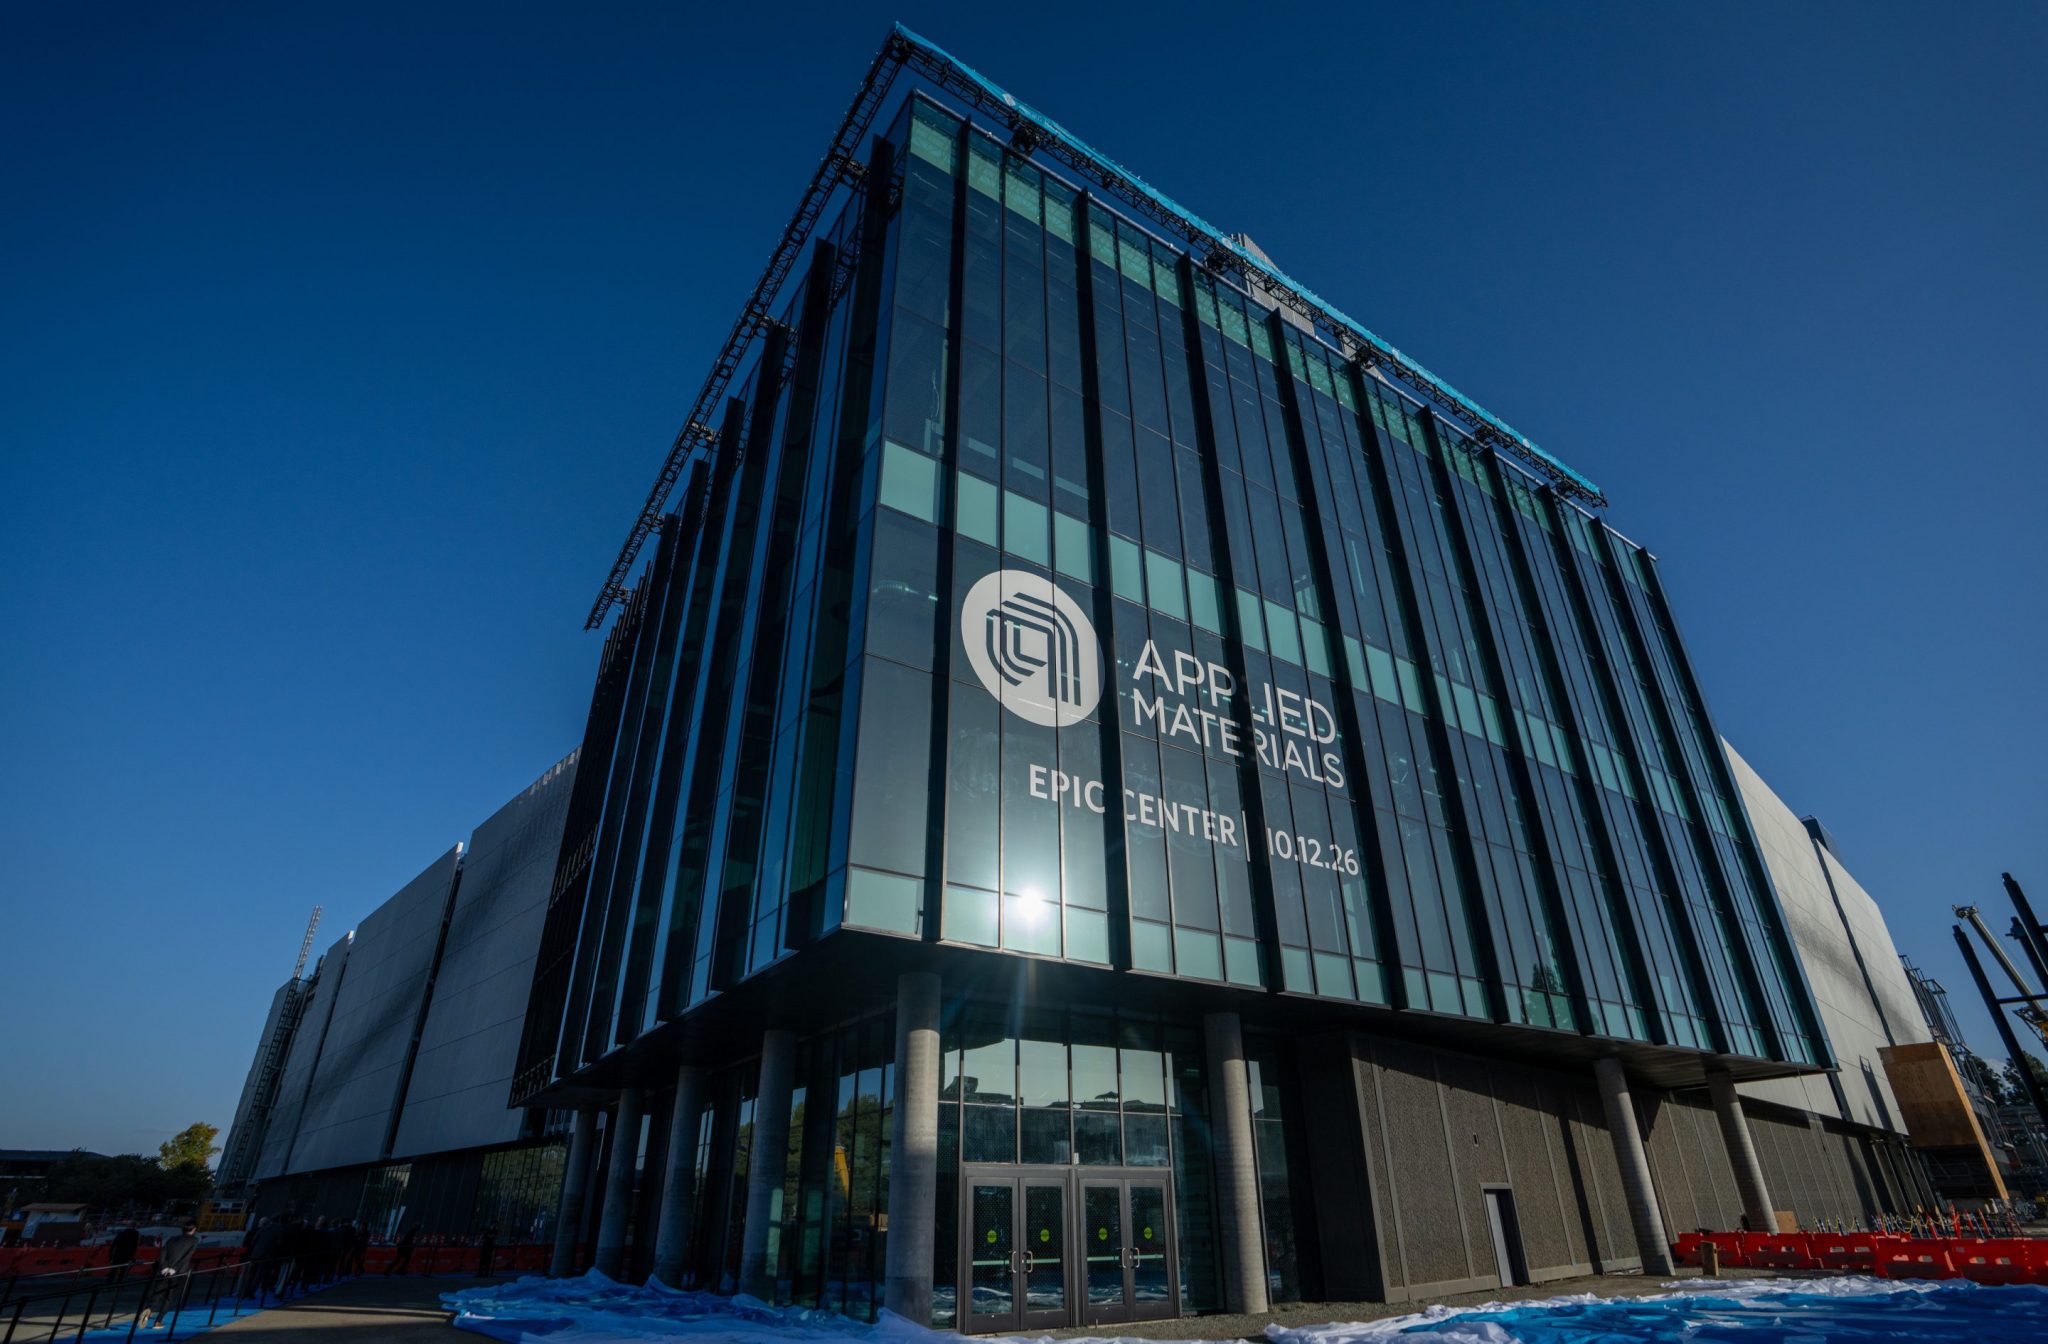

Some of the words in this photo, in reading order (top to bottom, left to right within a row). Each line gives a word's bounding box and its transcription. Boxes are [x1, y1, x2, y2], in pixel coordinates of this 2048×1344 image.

[1133, 688, 1344, 788] MATERIALS
[1029, 763, 1106, 814] EPIC
[1266, 827, 1360, 876] 10.12.26
